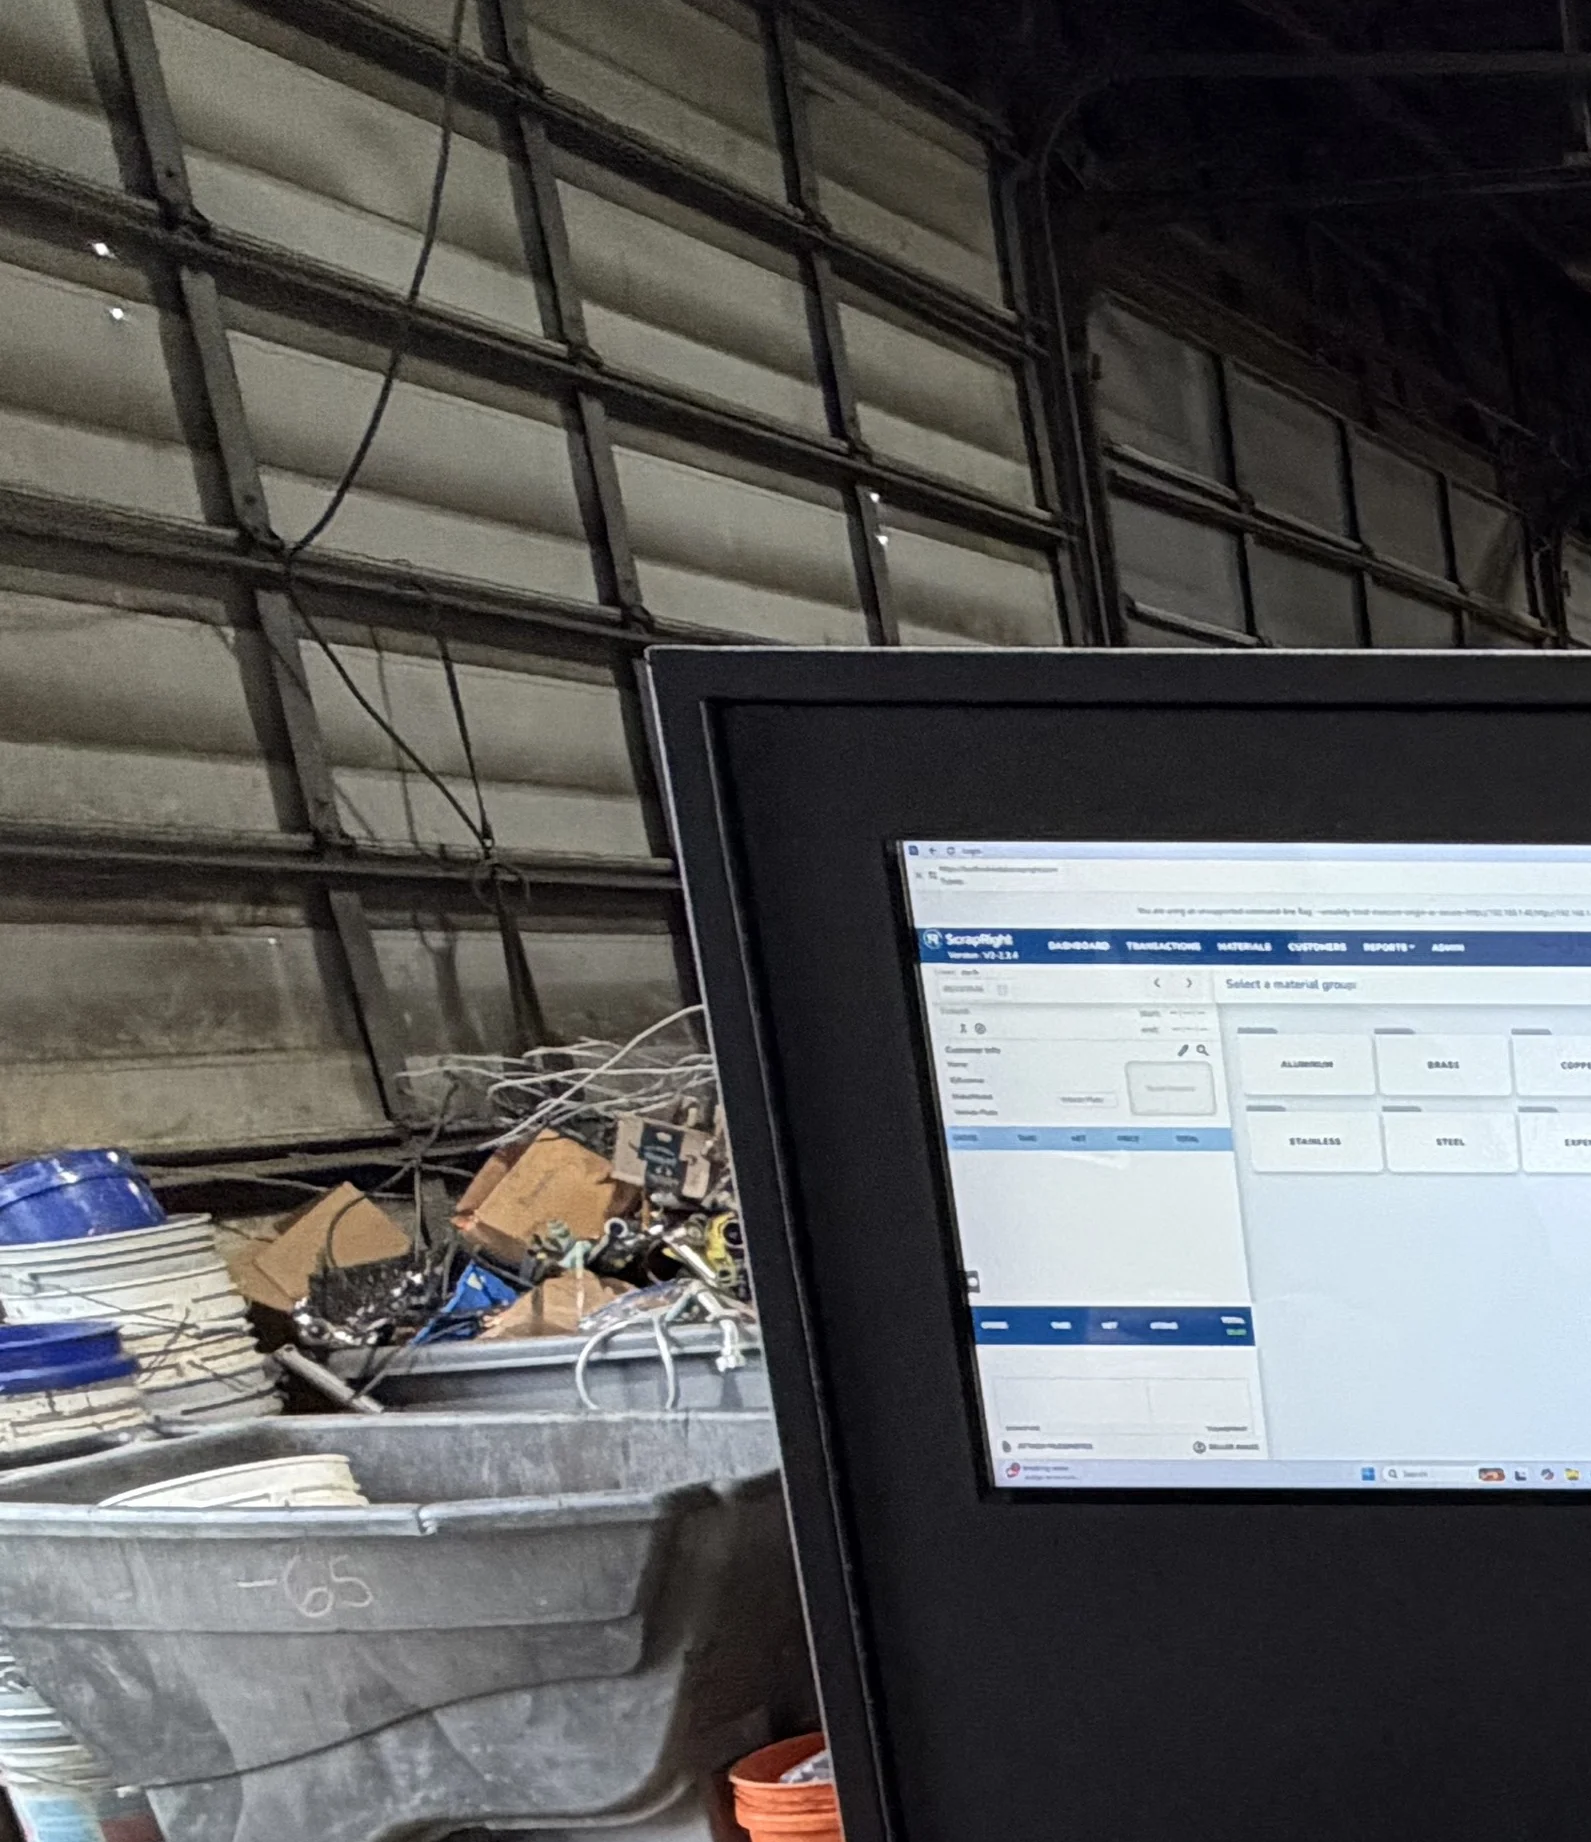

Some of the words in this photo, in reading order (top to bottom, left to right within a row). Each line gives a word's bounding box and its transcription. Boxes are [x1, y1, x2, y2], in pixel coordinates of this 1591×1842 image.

[945, 933, 1014, 949] ScrapRight
[1047, 940, 1111, 951] DASHBOARD
[1125, 941, 1203, 951] TRANSACTIONS
[1217, 941, 1273, 952] MATERIALS
[1287, 941, 1347, 952] CUSTOMERS
[1363, 942, 1409, 952] REPORTS
[1226, 978, 1262, 990] Select
[1264, 982, 1272, 990] a
[1273, 978, 1319, 990] material
[1427, 1060, 1460, 1070] BRASS
[1288, 1138, 1342, 1146] STAINLESS
[1436, 1138, 1466, 1147] STEEL
